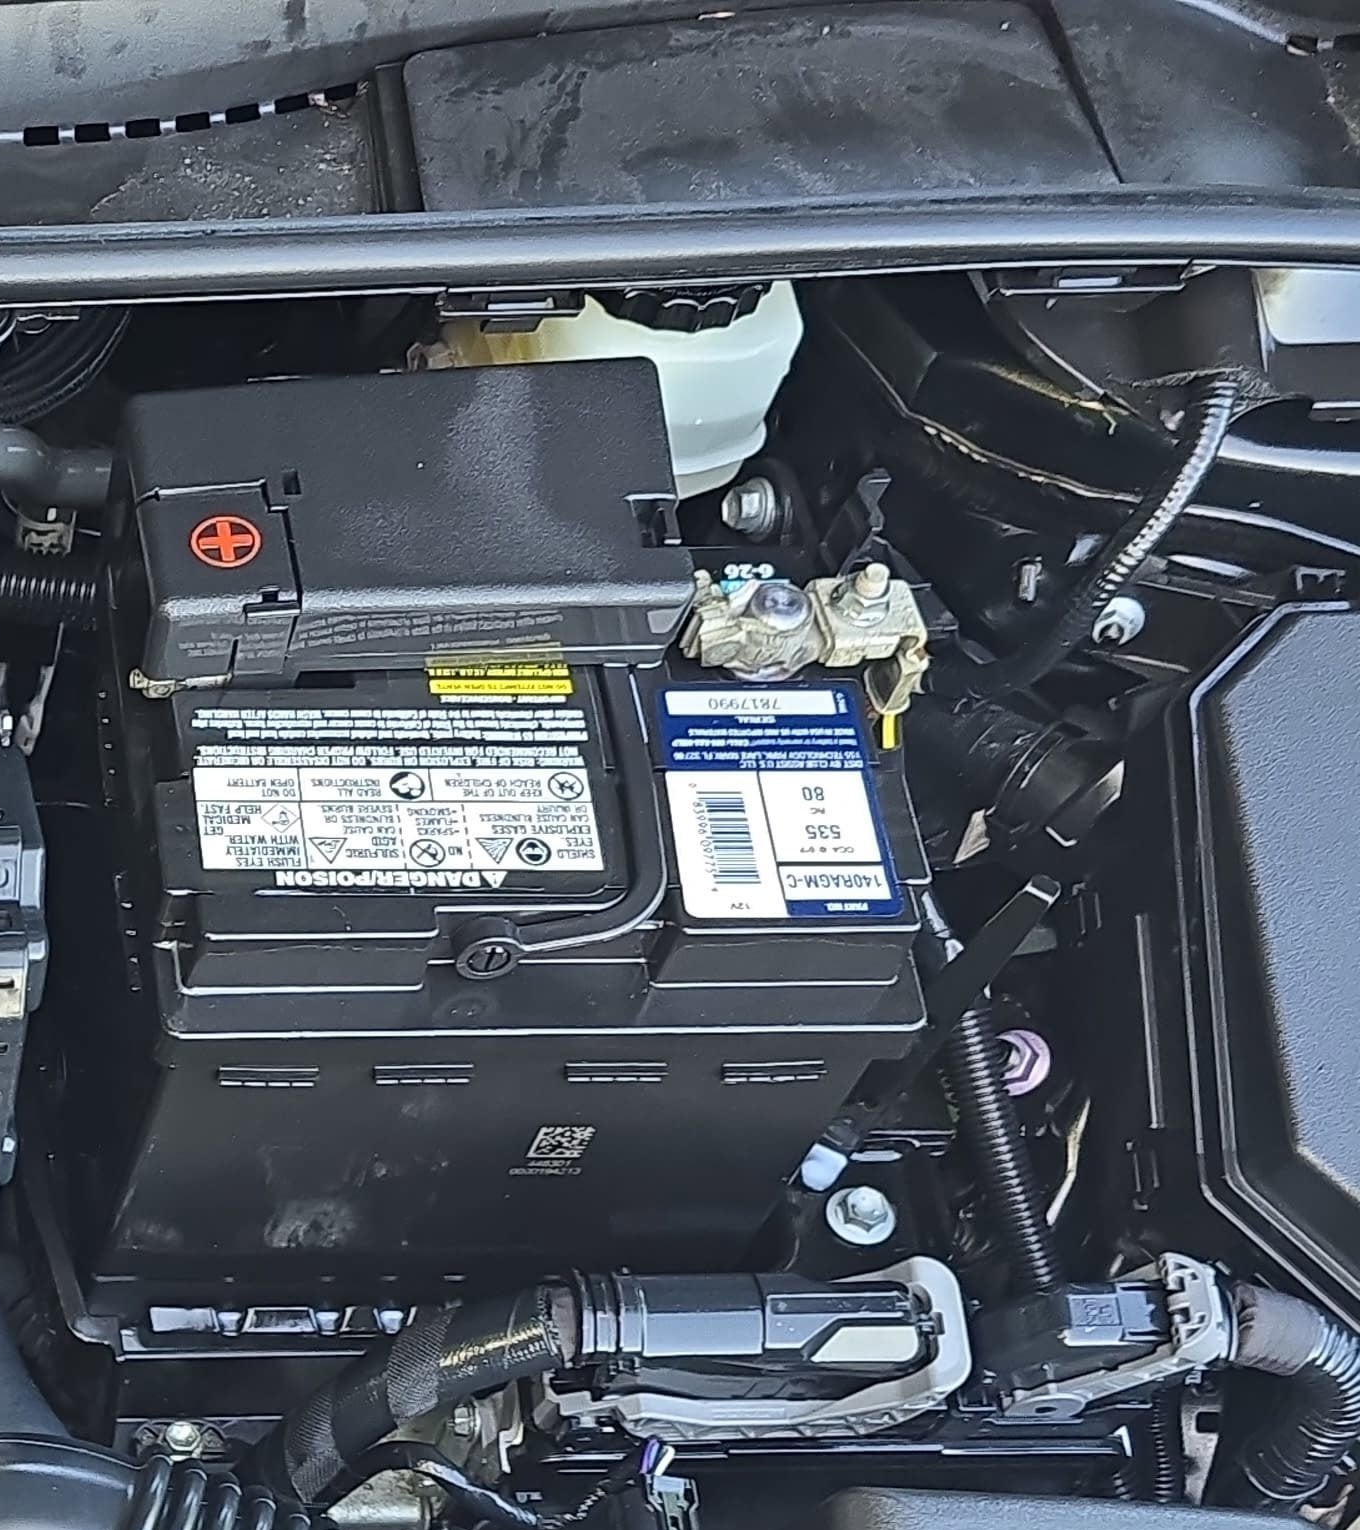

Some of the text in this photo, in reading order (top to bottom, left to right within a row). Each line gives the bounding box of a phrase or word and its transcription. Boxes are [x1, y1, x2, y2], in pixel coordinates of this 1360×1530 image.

[724, 563, 775, 580] 6-26
[801, 786, 825, 801] 80
[202, 815, 251, 824] MEDICAL
[204, 826, 224, 835] GET
[804, 824, 840, 840] 535
[269, 834, 299, 844] WITH
[225, 846, 300, 856] IMMEDIATELY
[235, 857, 301, 866] FLUSH EYES
[275, 870, 481, 887] DANGER/POISON
[786, 873, 882, 888] 140RAGM-C
